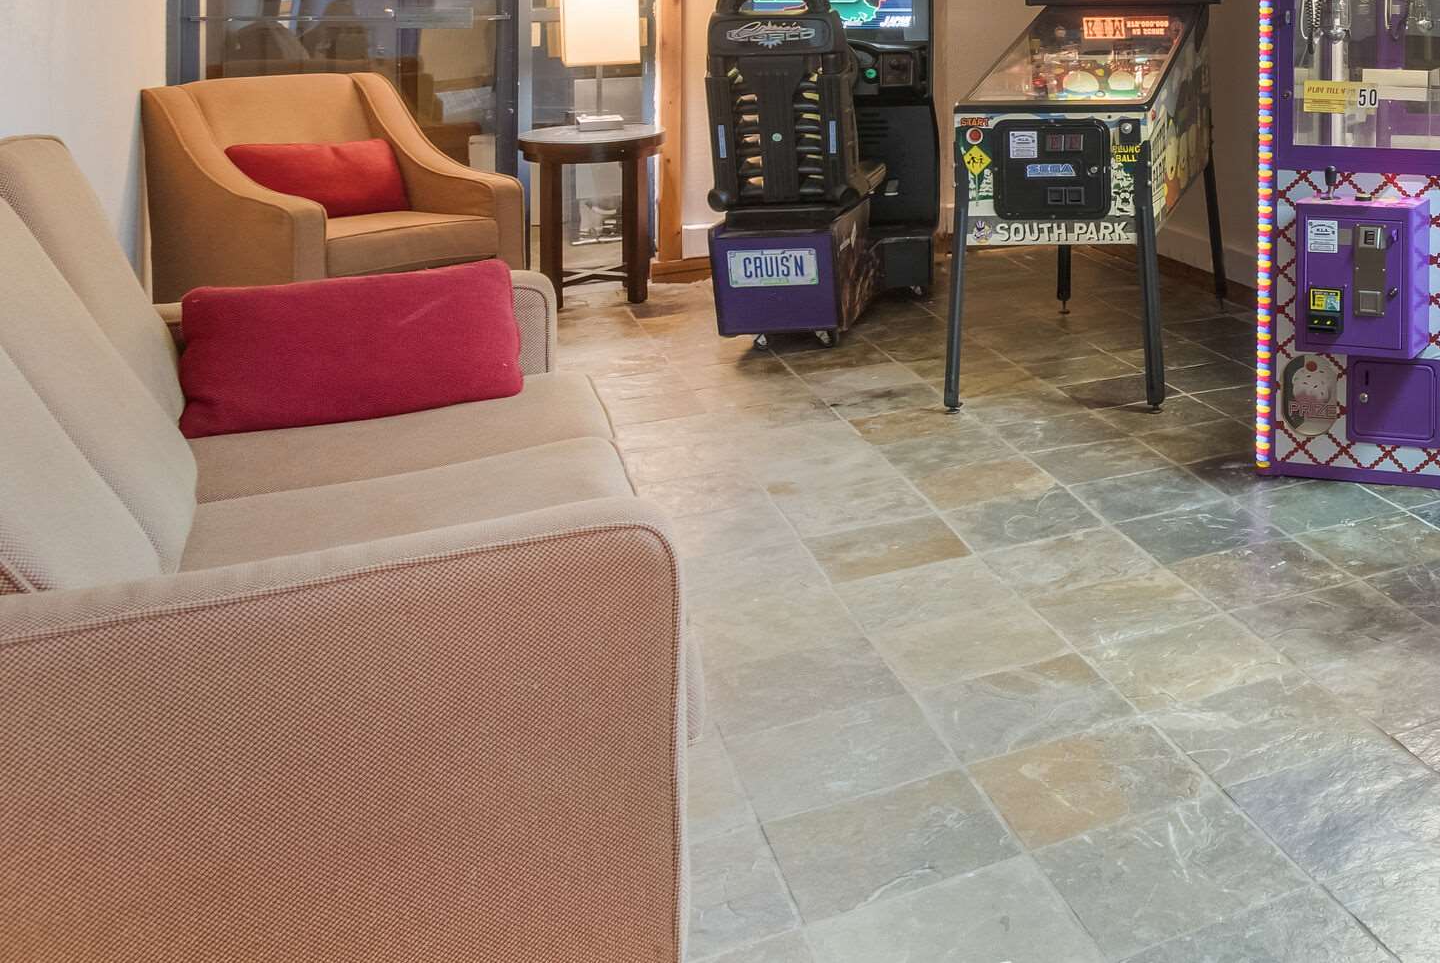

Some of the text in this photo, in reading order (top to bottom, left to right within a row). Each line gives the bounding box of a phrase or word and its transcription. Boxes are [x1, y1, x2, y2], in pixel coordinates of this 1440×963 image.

[1358, 88, 1378, 106] 50
[961, 117, 989, 127] START
[1115, 154, 1137, 163] BALL
[1026, 163, 1075, 176] SEGA
[995, 221, 1129, 243] SOUTH PARK
[743, 254, 805, 278] CRUIS'N
